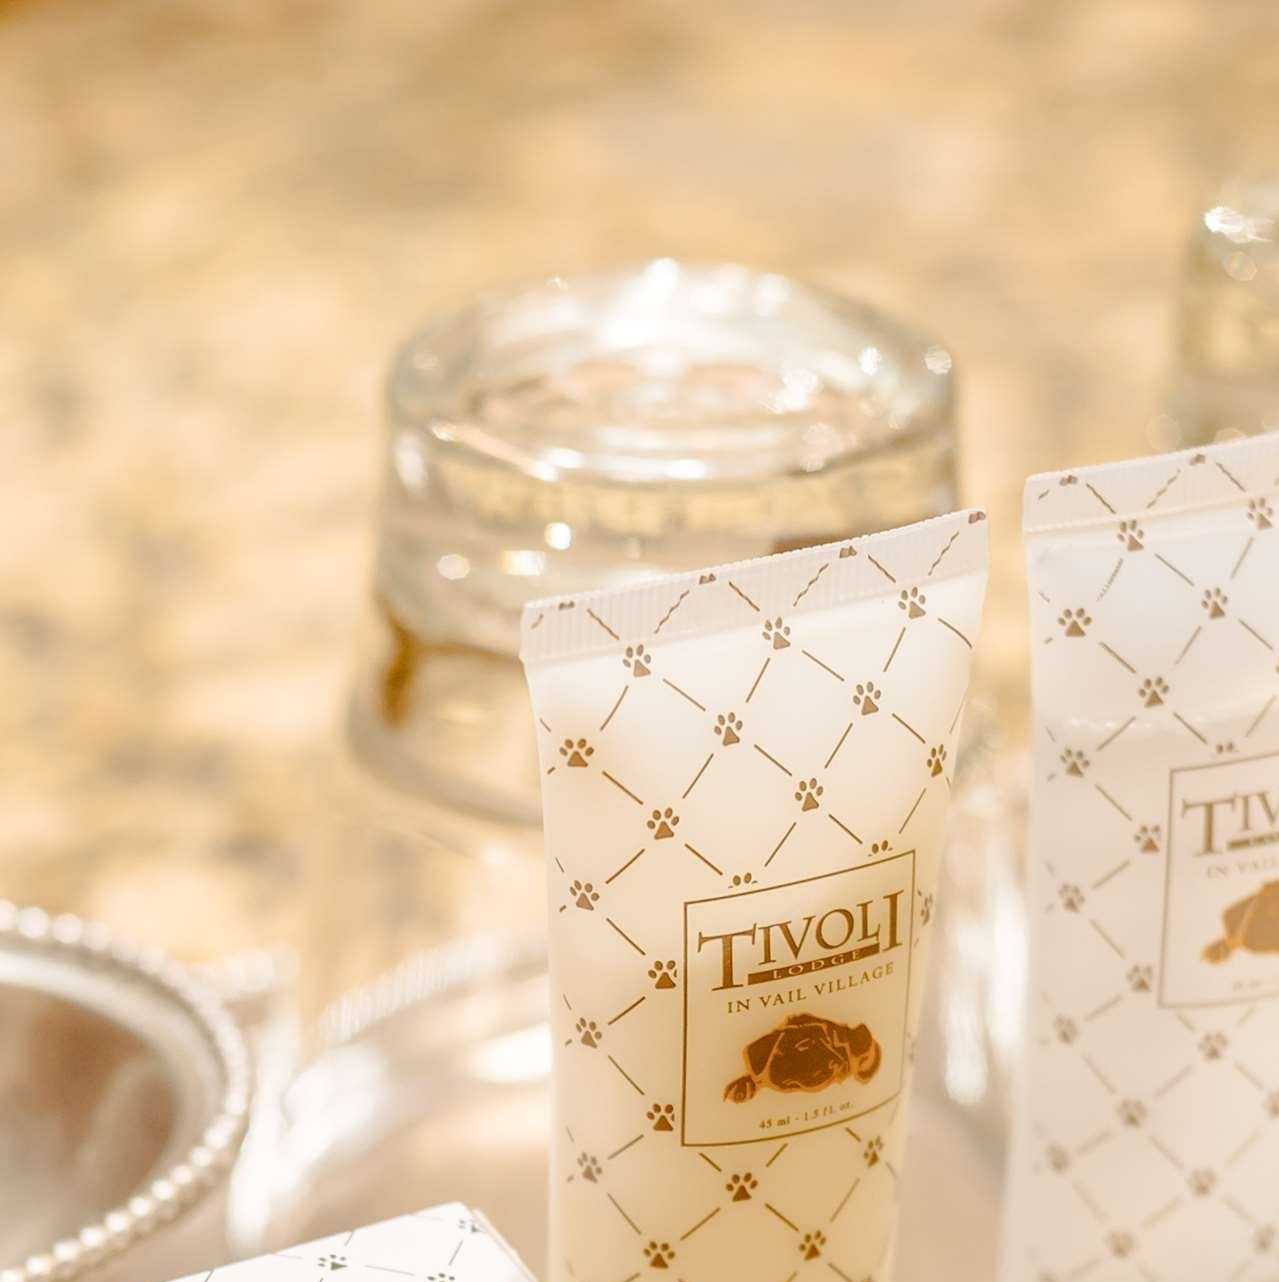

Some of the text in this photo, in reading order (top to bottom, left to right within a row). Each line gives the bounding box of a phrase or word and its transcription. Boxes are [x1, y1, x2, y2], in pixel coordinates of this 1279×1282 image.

[697, 889, 904, 992] TIVOLI
[772, 949, 861, 980] LODGE
[727, 961, 895, 1014] IN VAIL VILLAGE
